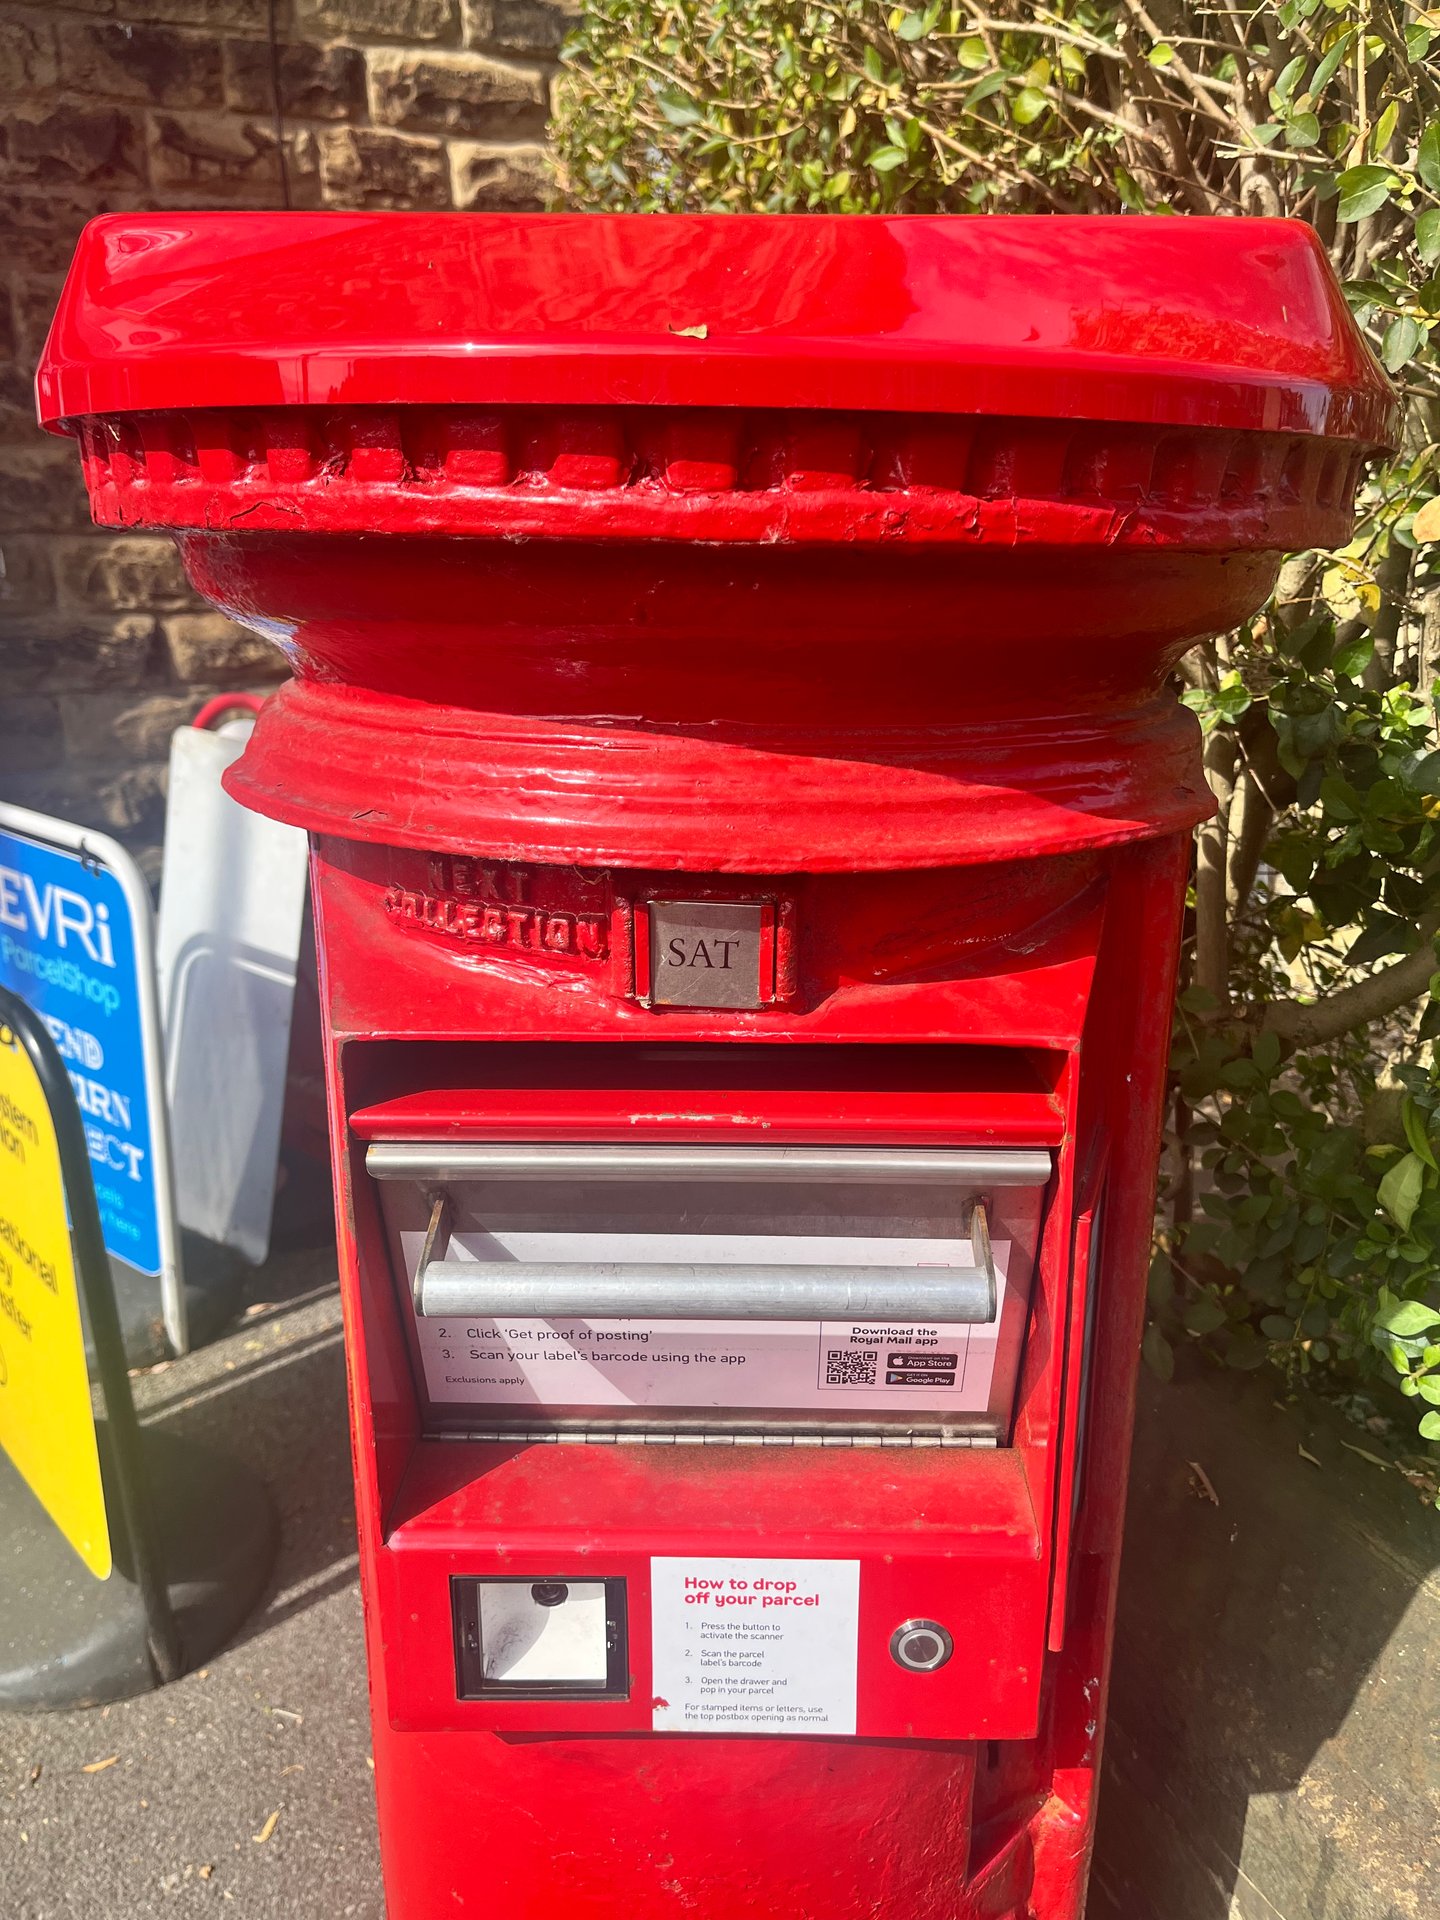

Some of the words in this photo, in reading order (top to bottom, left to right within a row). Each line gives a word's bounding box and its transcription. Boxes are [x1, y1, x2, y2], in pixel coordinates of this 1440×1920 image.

[669, 938, 740, 969] SAT
[1, 936, 120, 1017] ParcelShop
[44, 1014, 104, 1071] END
[438, 1329, 451, 1338] 2.
[467, 1328, 501, 1340] Click
[537, 1329, 574, 1342] proof
[579, 1330, 593, 1341] of
[917, 1328, 937, 1336] the
[850, 1336, 883, 1345] Royal
[443, 1350, 455, 1359] 3.
[470, 1350, 503, 1360] Scan
[508, 1352, 540, 1363] your
[592, 1352, 648, 1362] barcode
[652, 1354, 689, 1364] using
[694, 1353, 717, 1363] the
[721, 1356, 746, 1365] app
[446, 1376, 496, 1384] Exclusions
[500, 1377, 524, 1386] apply
[685, 1577, 724, 1589] How
[729, 1578, 747, 1590] to
[754, 1578, 796, 1593] drop
[685, 1592, 710, 1604] off
[715, 1595, 758, 1607] your
[763, 1594, 819, 1608] parcel
[685, 1622, 692, 1630] 1.
[743, 1623, 770, 1631] button
[724, 1650, 737, 1658] the
[739, 1651, 764, 1659] parcel
[729, 1659, 762, 1667] barcode
[701, 1677, 722, 1686] Open
[725, 1677, 738, 1685] the
[728, 1687, 746, 1695] your
[749, 1687, 774, 1695] parcel
[702, 1704, 737, 1712] stamped
[740, 1704, 763, 1712] items
[777, 1705, 805, 1713] letters,
[685, 1712, 698, 1720] the
[701, 1713, 714, 1721] top
[716, 1713, 749, 1721] postbox
[751, 1714, 784, 1722] opening
